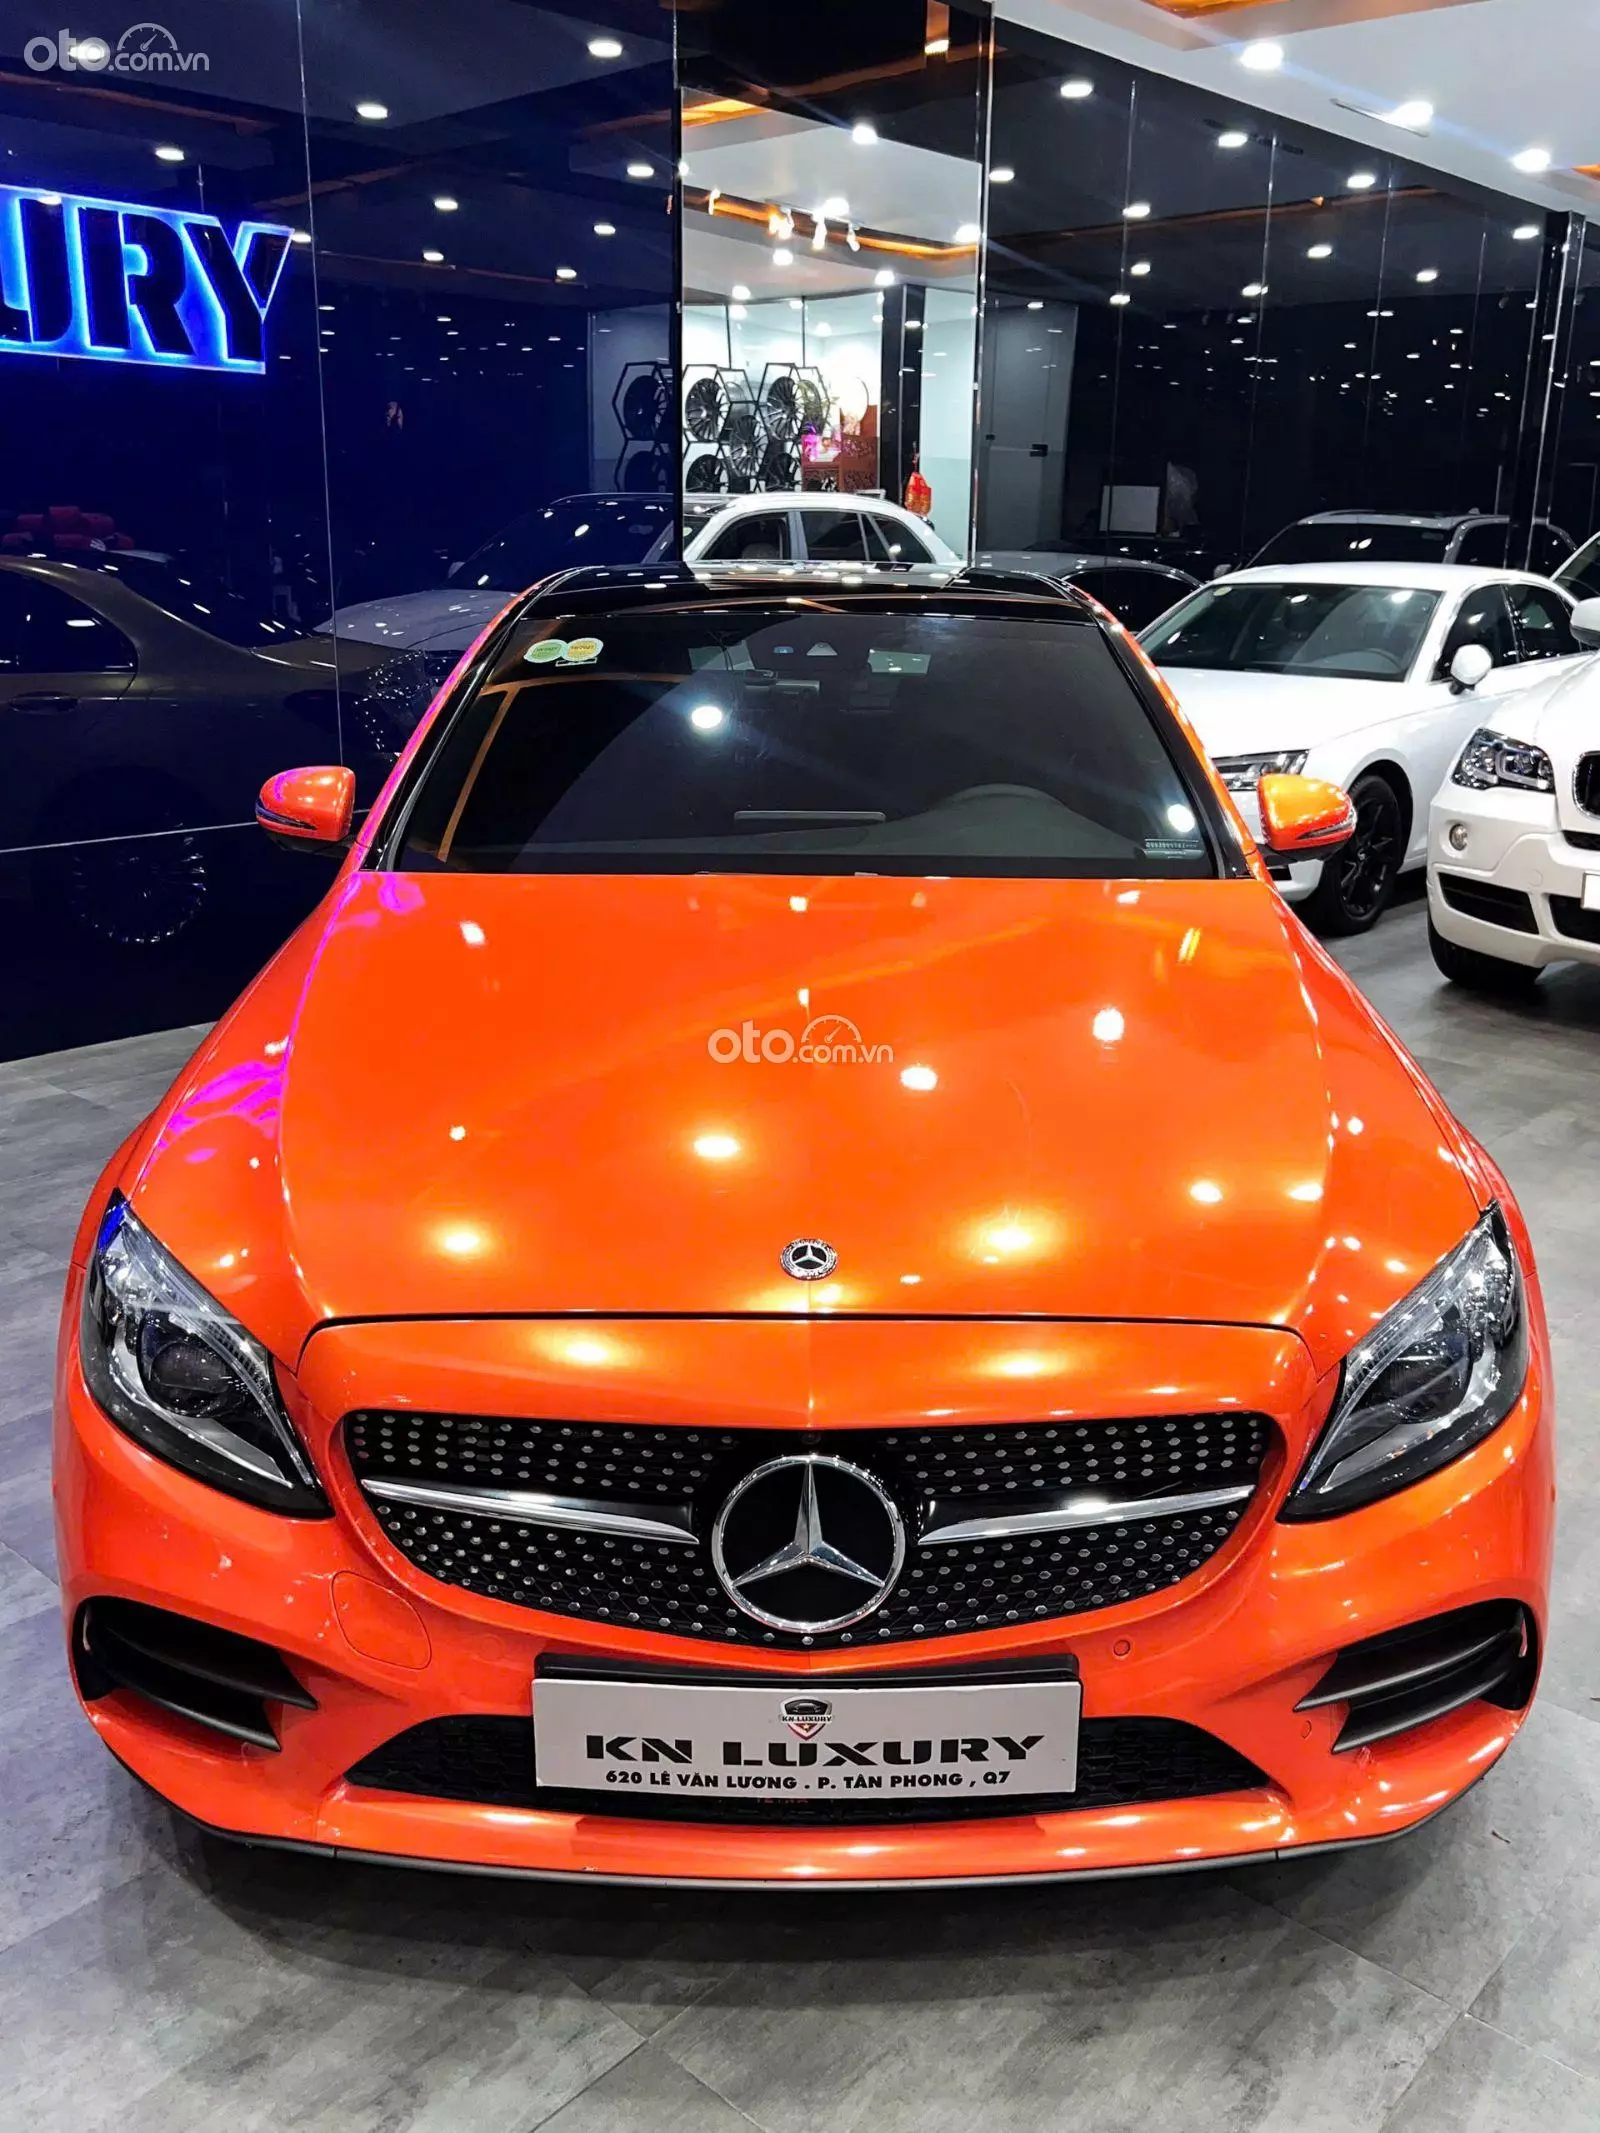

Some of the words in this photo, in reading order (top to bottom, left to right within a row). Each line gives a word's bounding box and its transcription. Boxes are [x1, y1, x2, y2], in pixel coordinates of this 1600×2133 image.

[586, 1734, 693, 1764] KN
[722, 1735, 1045, 1767] LUXURY
[605, 1770, 643, 1785] 620
[650, 1770, 671, 1786] LÊ
[677, 1772, 719, 1788] VĂN
[726, 1775, 798, 1790] LƯƠNG
[818, 1776, 837, 1789] P.
[843, 1773, 883, 1789] TÂN
[890, 1773, 963, 1788] PHONG
[983, 1770, 1011, 1785] Q7
